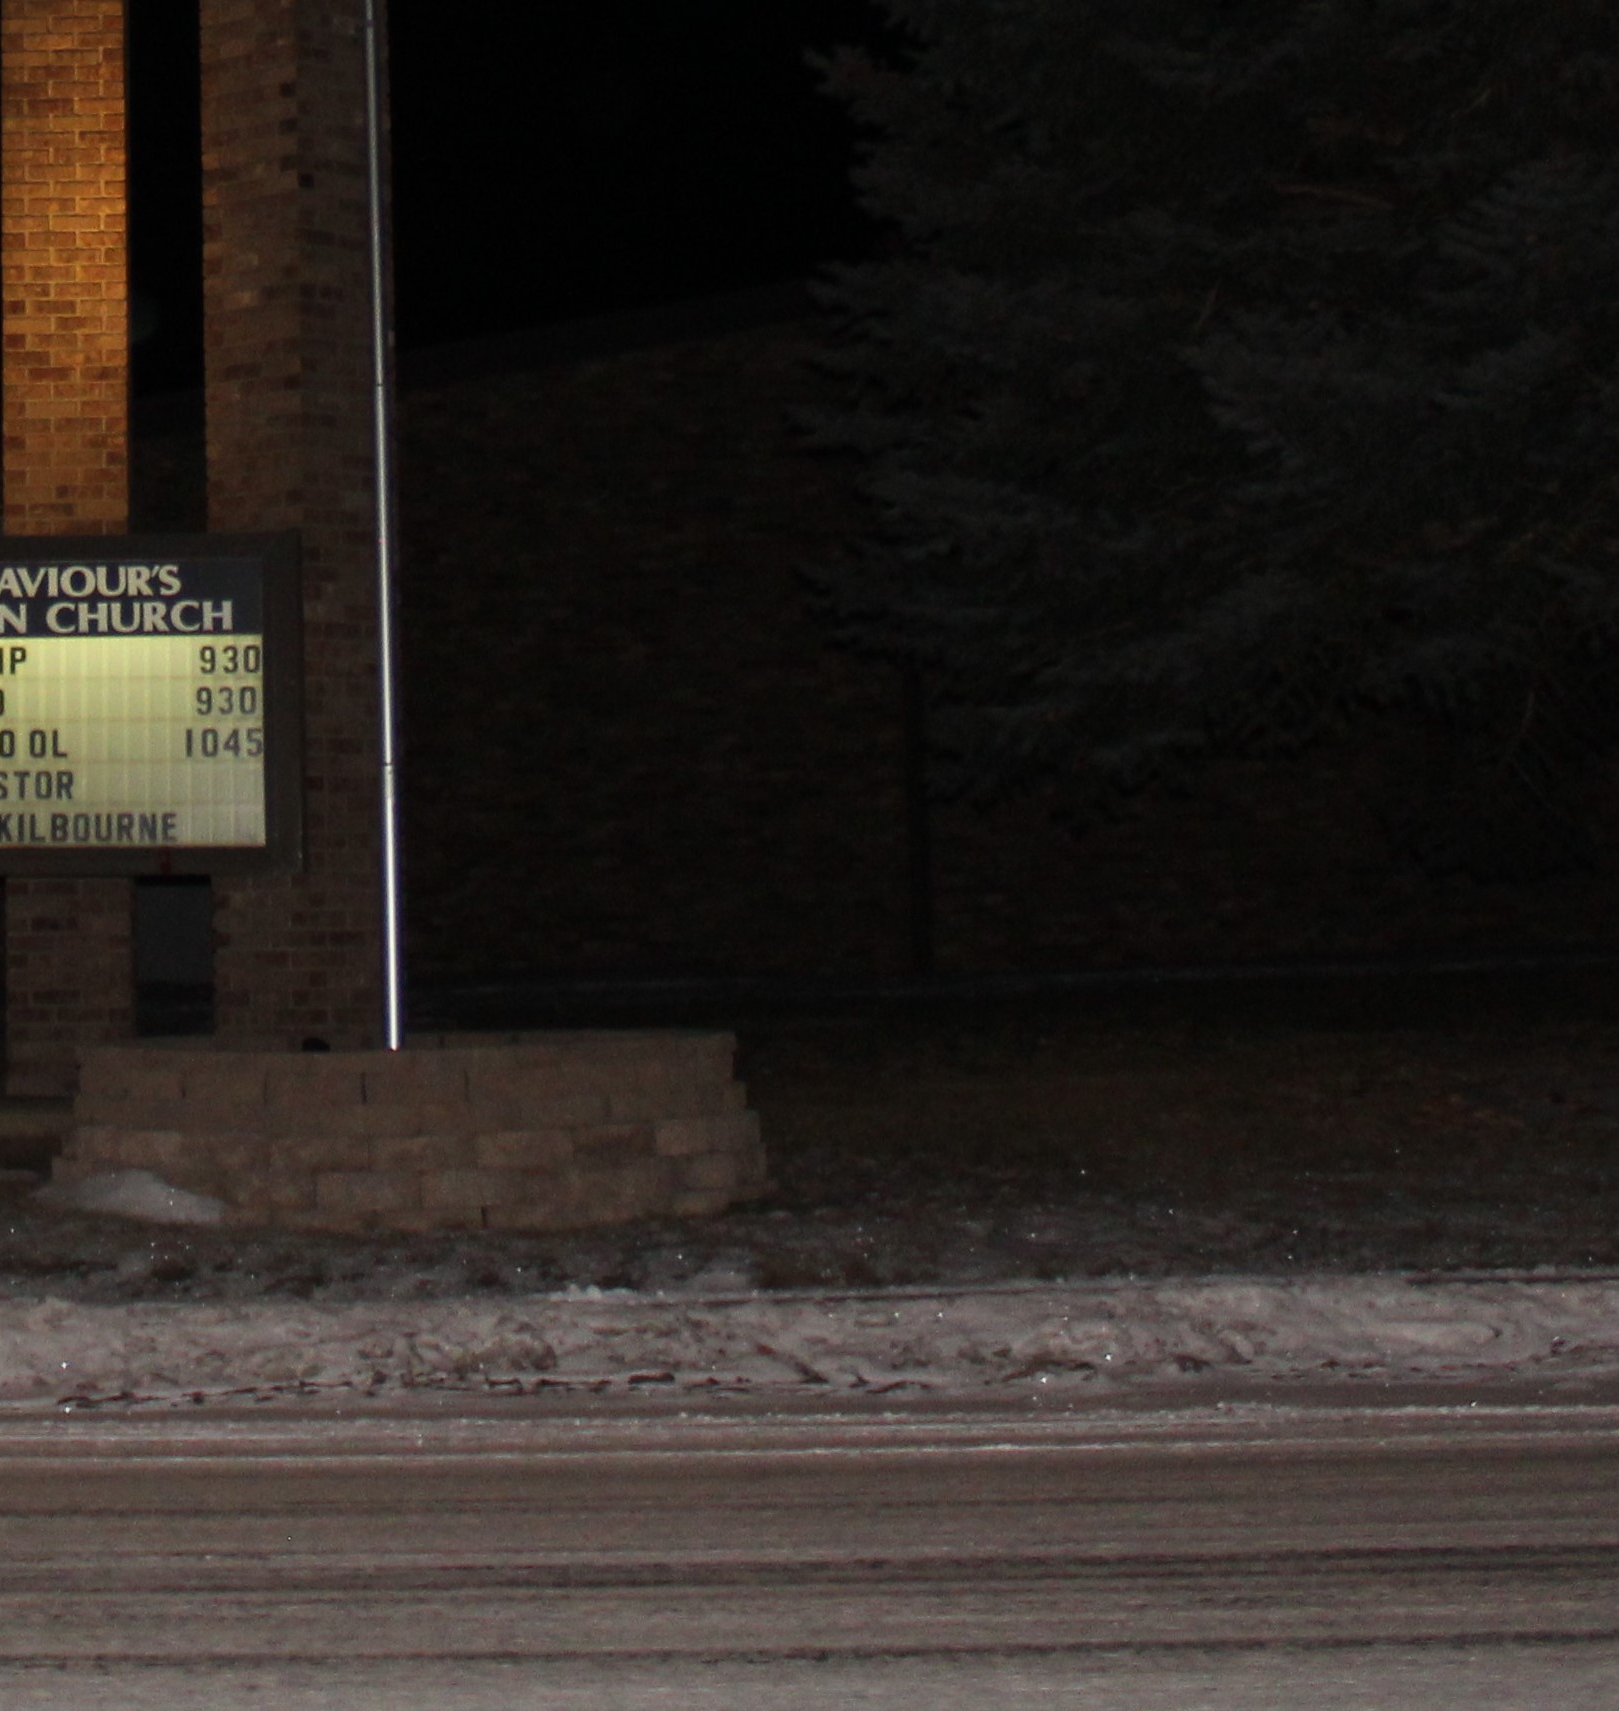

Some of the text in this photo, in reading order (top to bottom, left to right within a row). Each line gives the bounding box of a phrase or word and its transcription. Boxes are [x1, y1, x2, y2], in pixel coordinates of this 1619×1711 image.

[45, 601, 233, 633] CHURCH
[199, 646, 262, 674] 930
[196, 687, 257, 715] 930
[184, 728, 264, 758] 1045
